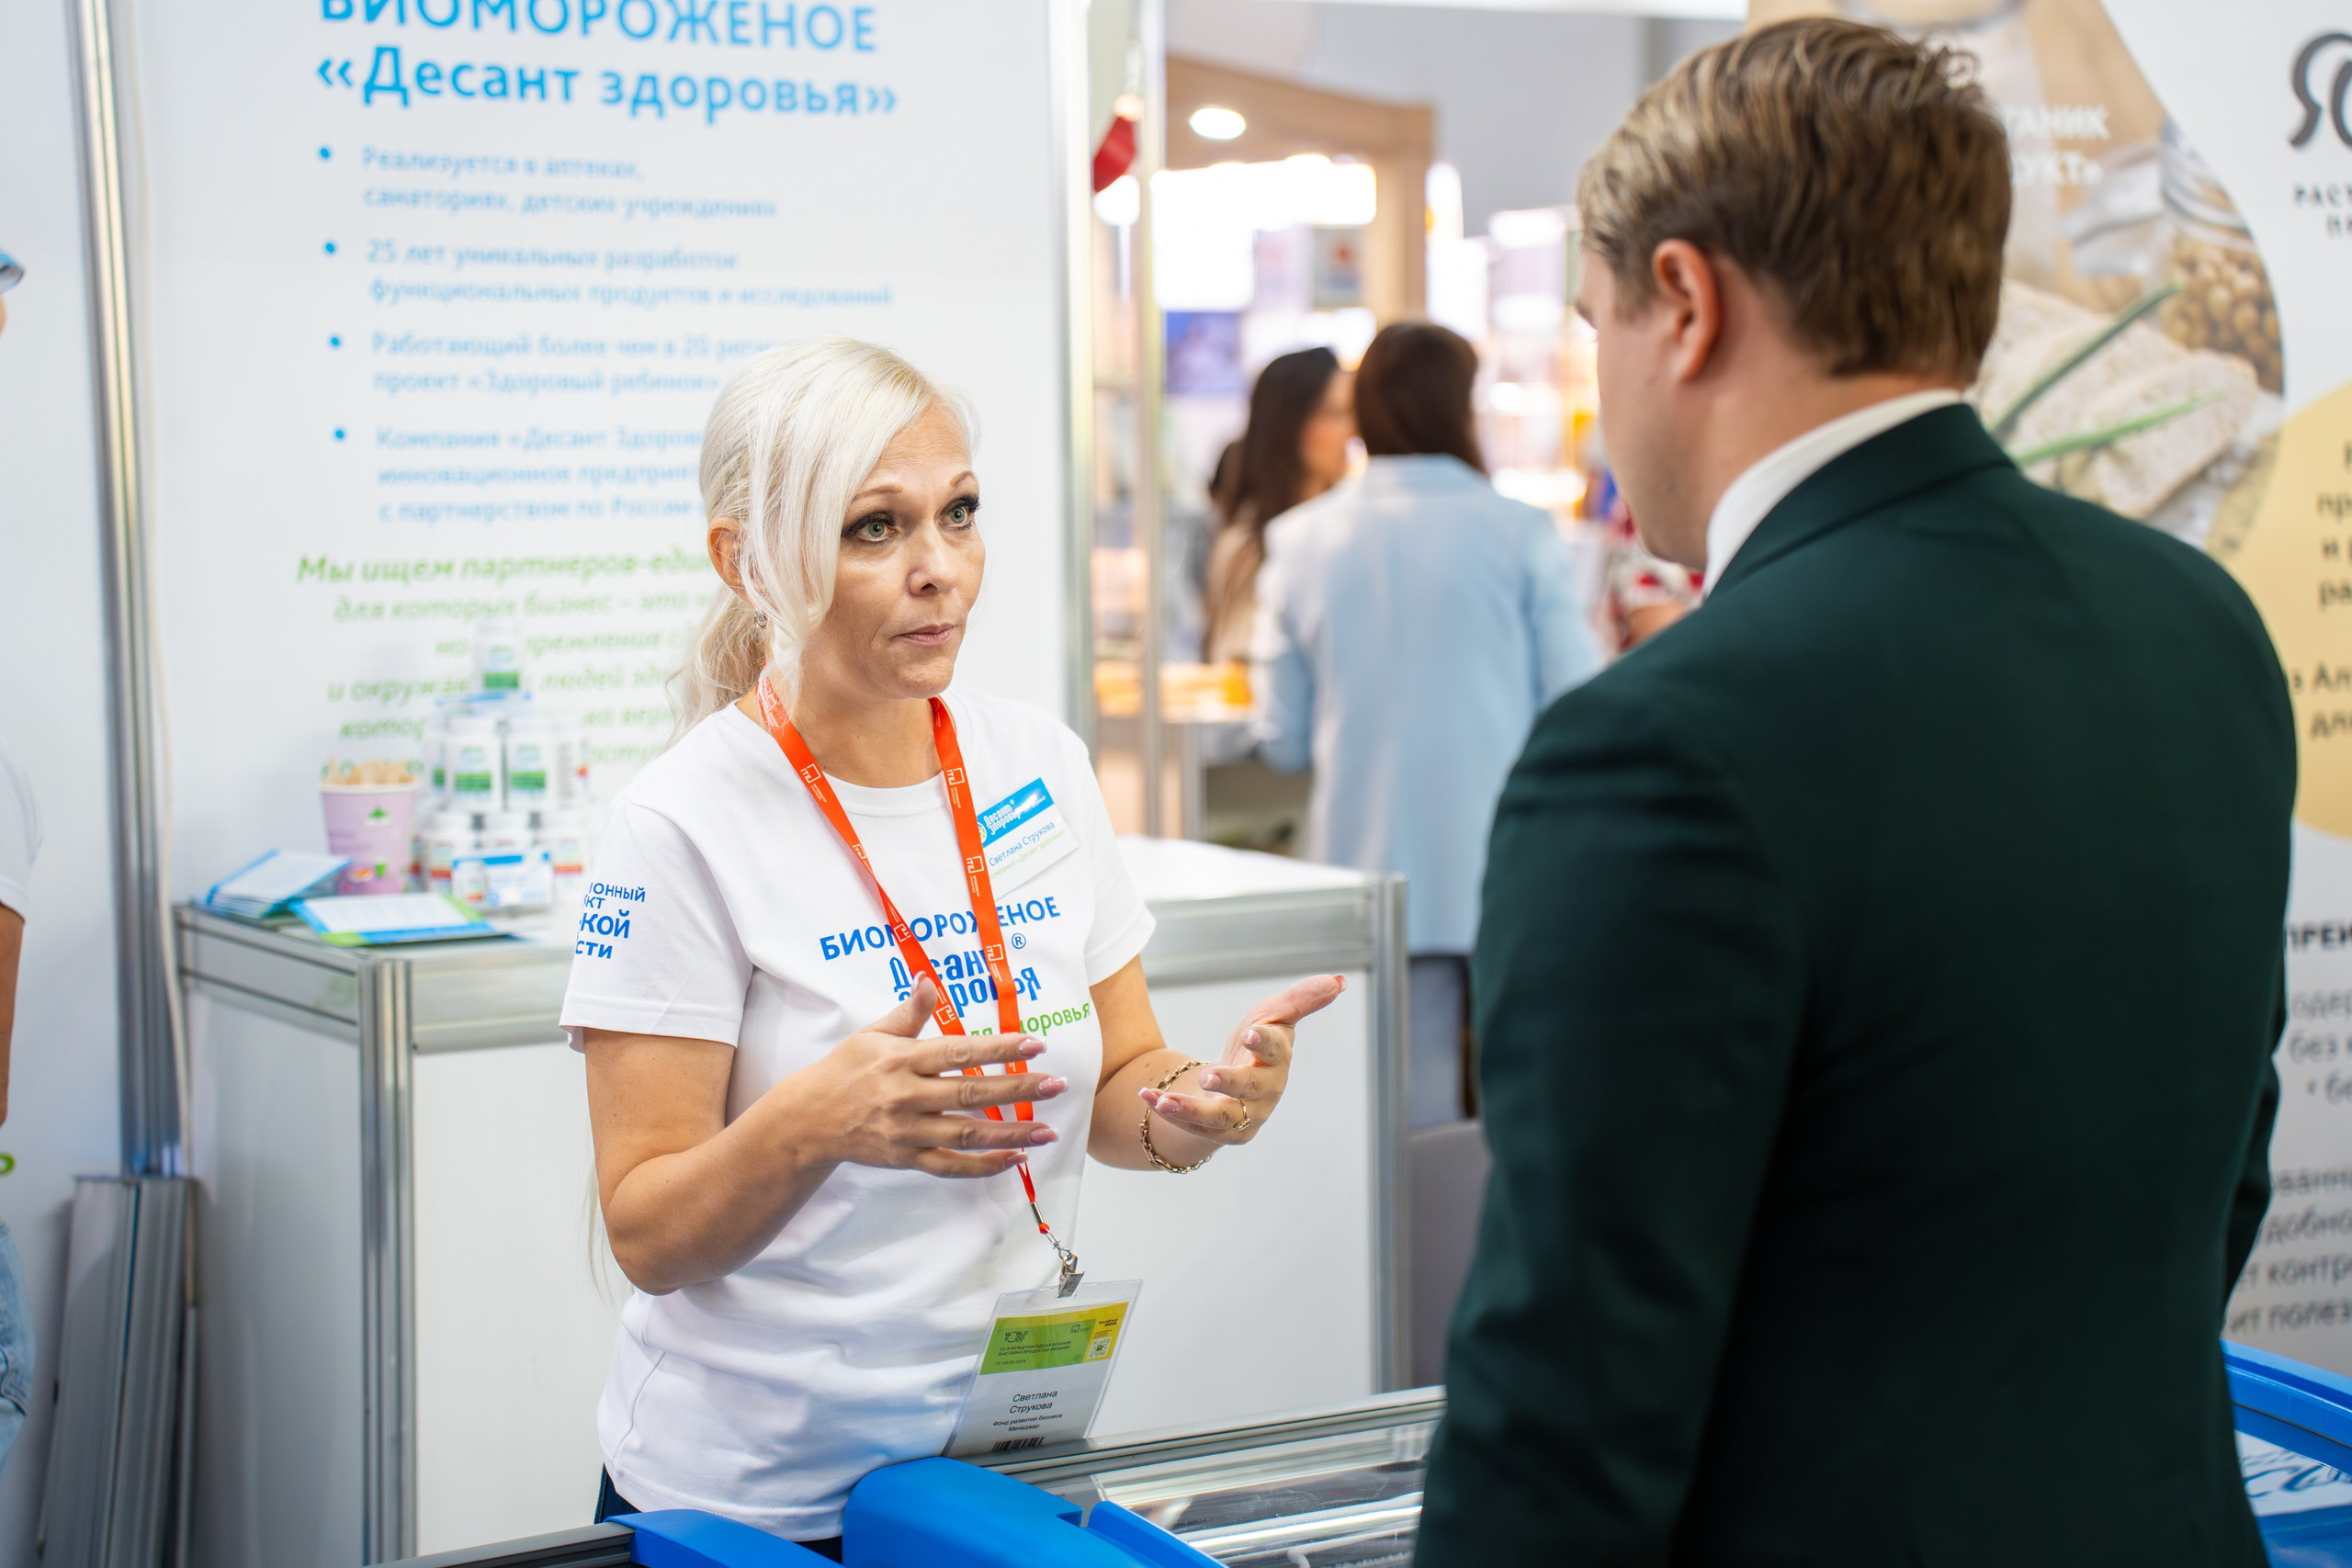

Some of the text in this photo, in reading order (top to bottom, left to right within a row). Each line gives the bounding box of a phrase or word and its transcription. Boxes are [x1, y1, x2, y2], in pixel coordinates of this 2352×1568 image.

[317, 45, 898, 125] «Десант здоровья»
[297, 555, 355, 583] Мы
[989, 821, 1056, 866] Светлана Струкова
[589, 882, 646, 903] ОННЫЙ
[580, 908, 630, 939] КОЙ
[1009, 1402, 1053, 1414] Струкова
[1012, 1391, 1058, 1403] Светлана
